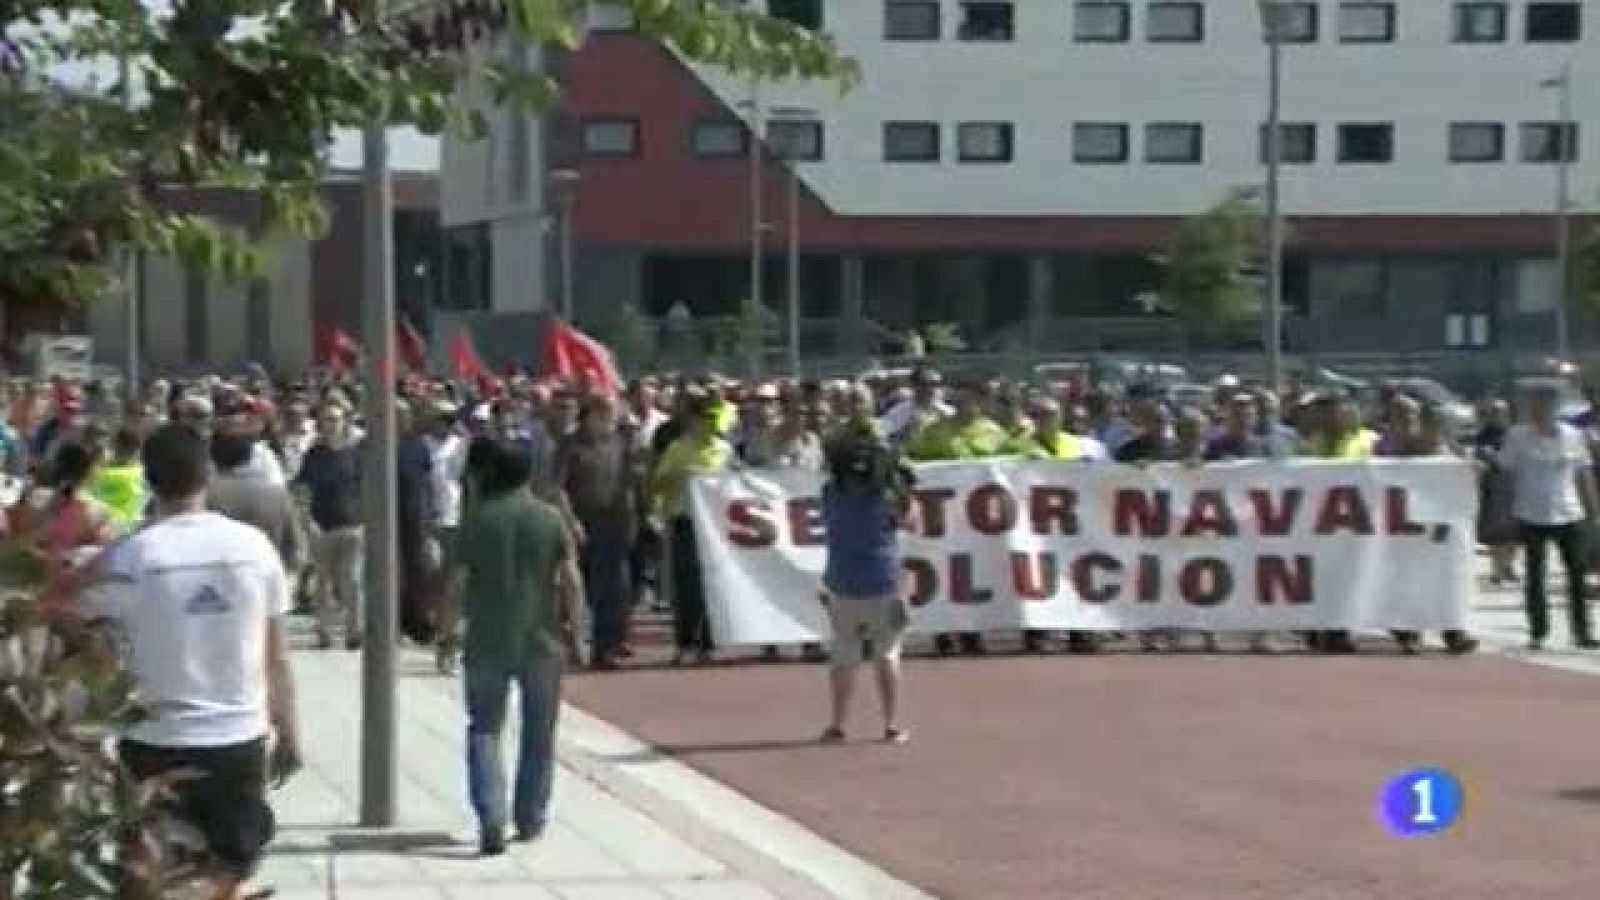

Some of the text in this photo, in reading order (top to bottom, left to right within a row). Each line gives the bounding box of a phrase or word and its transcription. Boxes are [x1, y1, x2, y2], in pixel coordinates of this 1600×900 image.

[727, 483, 1452, 547] SETOR NAVAL,
[902, 552, 1316, 607] OLUCION
